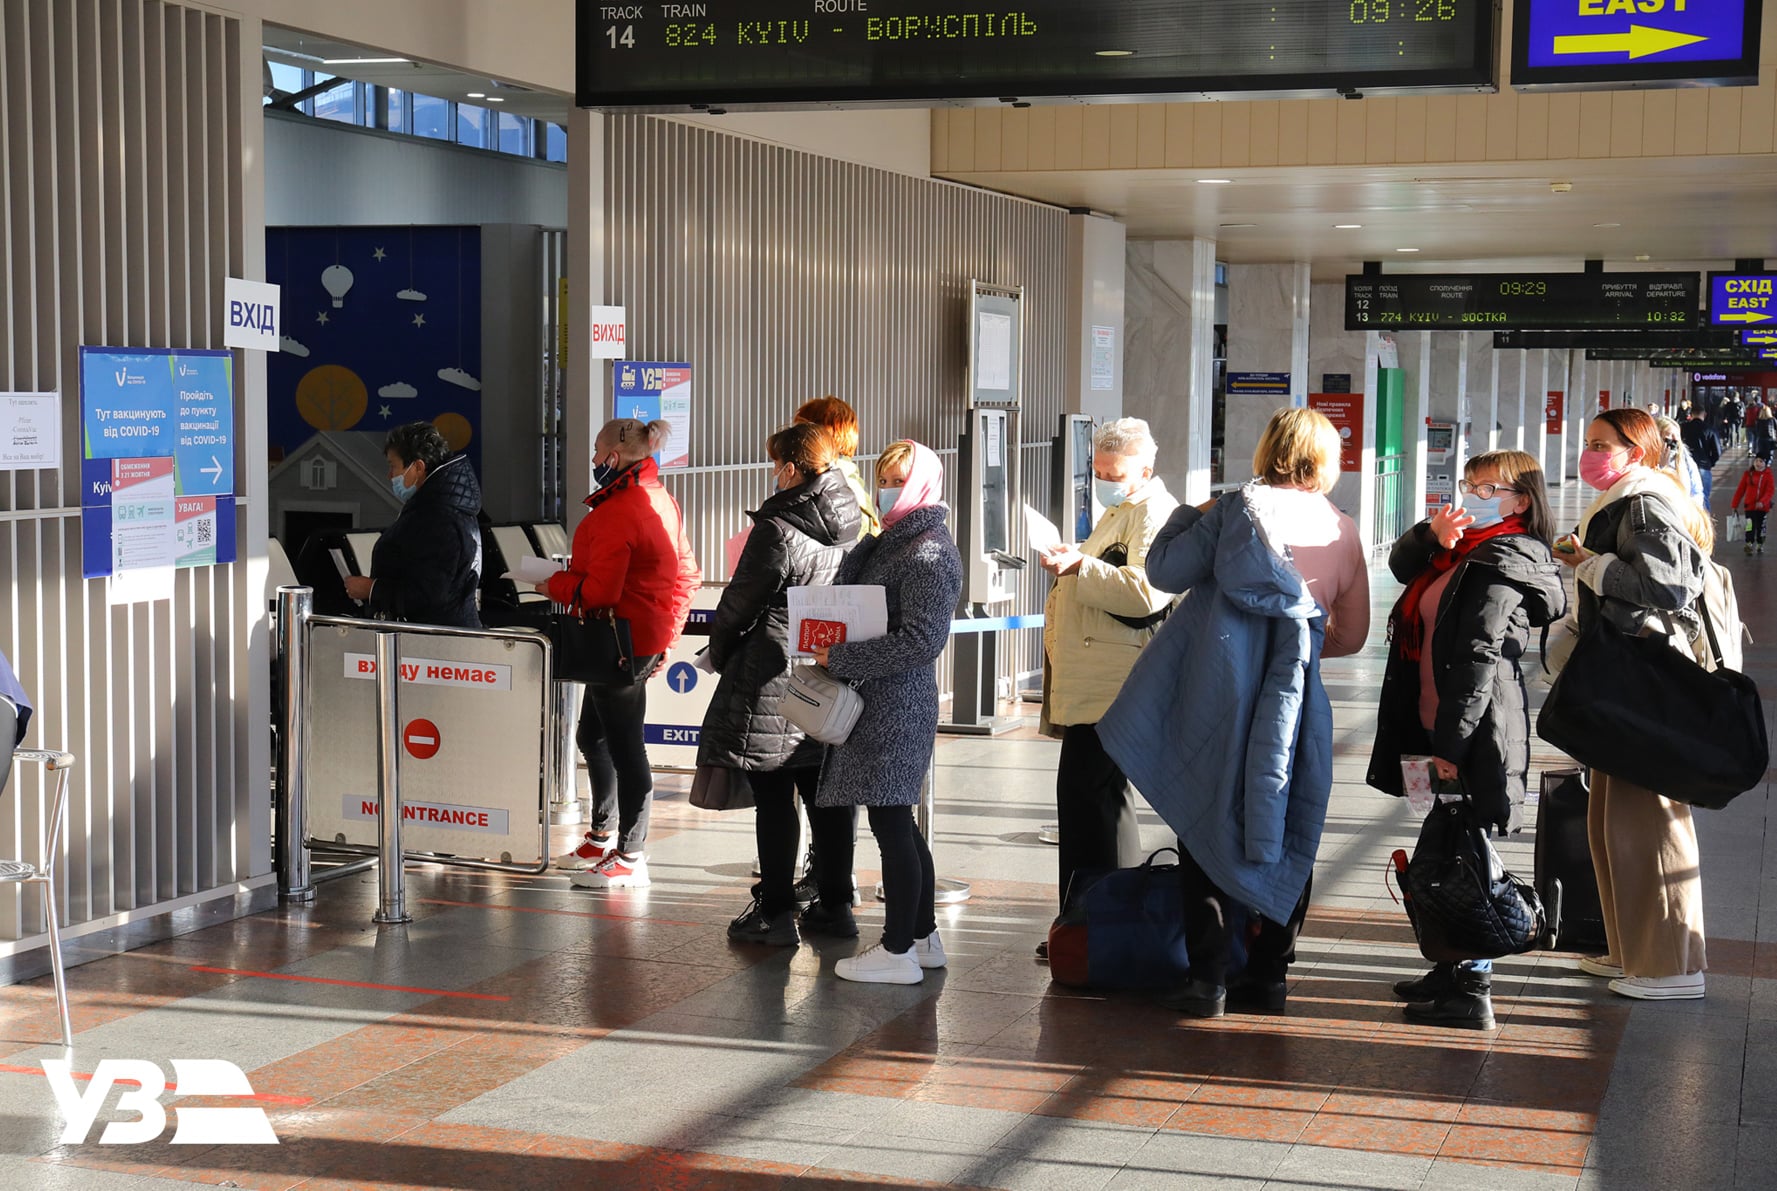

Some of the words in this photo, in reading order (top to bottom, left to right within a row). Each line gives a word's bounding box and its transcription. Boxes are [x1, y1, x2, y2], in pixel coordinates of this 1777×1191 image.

[600, 6, 643, 20] TRACK
[661, 3, 706, 18] TRAIN
[814, 0, 867, 13] ROUTE
[1349, 0, 1455, 24] 09:26
[1578, 0, 1688, 16] EAST
[606, 24, 635, 49] 14
[665, 23, 717, 47] 824
[738, 20, 809, 44] KYIV
[1500, 282, 1546, 295] 09:29
[1725, 279, 1772, 294] СХІД
[1356, 299, 1369, 310] 12
[1728, 297, 1769, 309] EAST
[231, 300, 275, 337] ВХІД
[1355, 312, 1369, 322] 13
[1380, 312, 1402, 322] 774
[1409, 312, 1440, 322] KYIV
[1647, 311, 1686, 322] 10:32
[593, 323, 625, 344] ВИХІД
[1702, 373, 1727, 381] vodafone
[180, 390, 214, 402] Пройдіть
[95, 408, 111, 421] Тут
[112, 409, 167, 421] вакцинують
[180, 407, 190, 416] до
[191, 406, 217, 417] пункту
[103, 425, 119, 438] від
[120, 425, 160, 437] COVID-19
[180, 420, 220, 431] вакцинації
[180, 435, 192, 446] від
[193, 434, 227, 445] COVID-19
[93, 480, 112, 496] Kyiv
[178, 502, 203, 513] УВАГА!
[803, 620, 811, 649] ПАСПОРТ
[427, 665, 497, 684] немає
[663, 729, 699, 742] EXIT
[404, 806, 489, 827] NTRANCE
